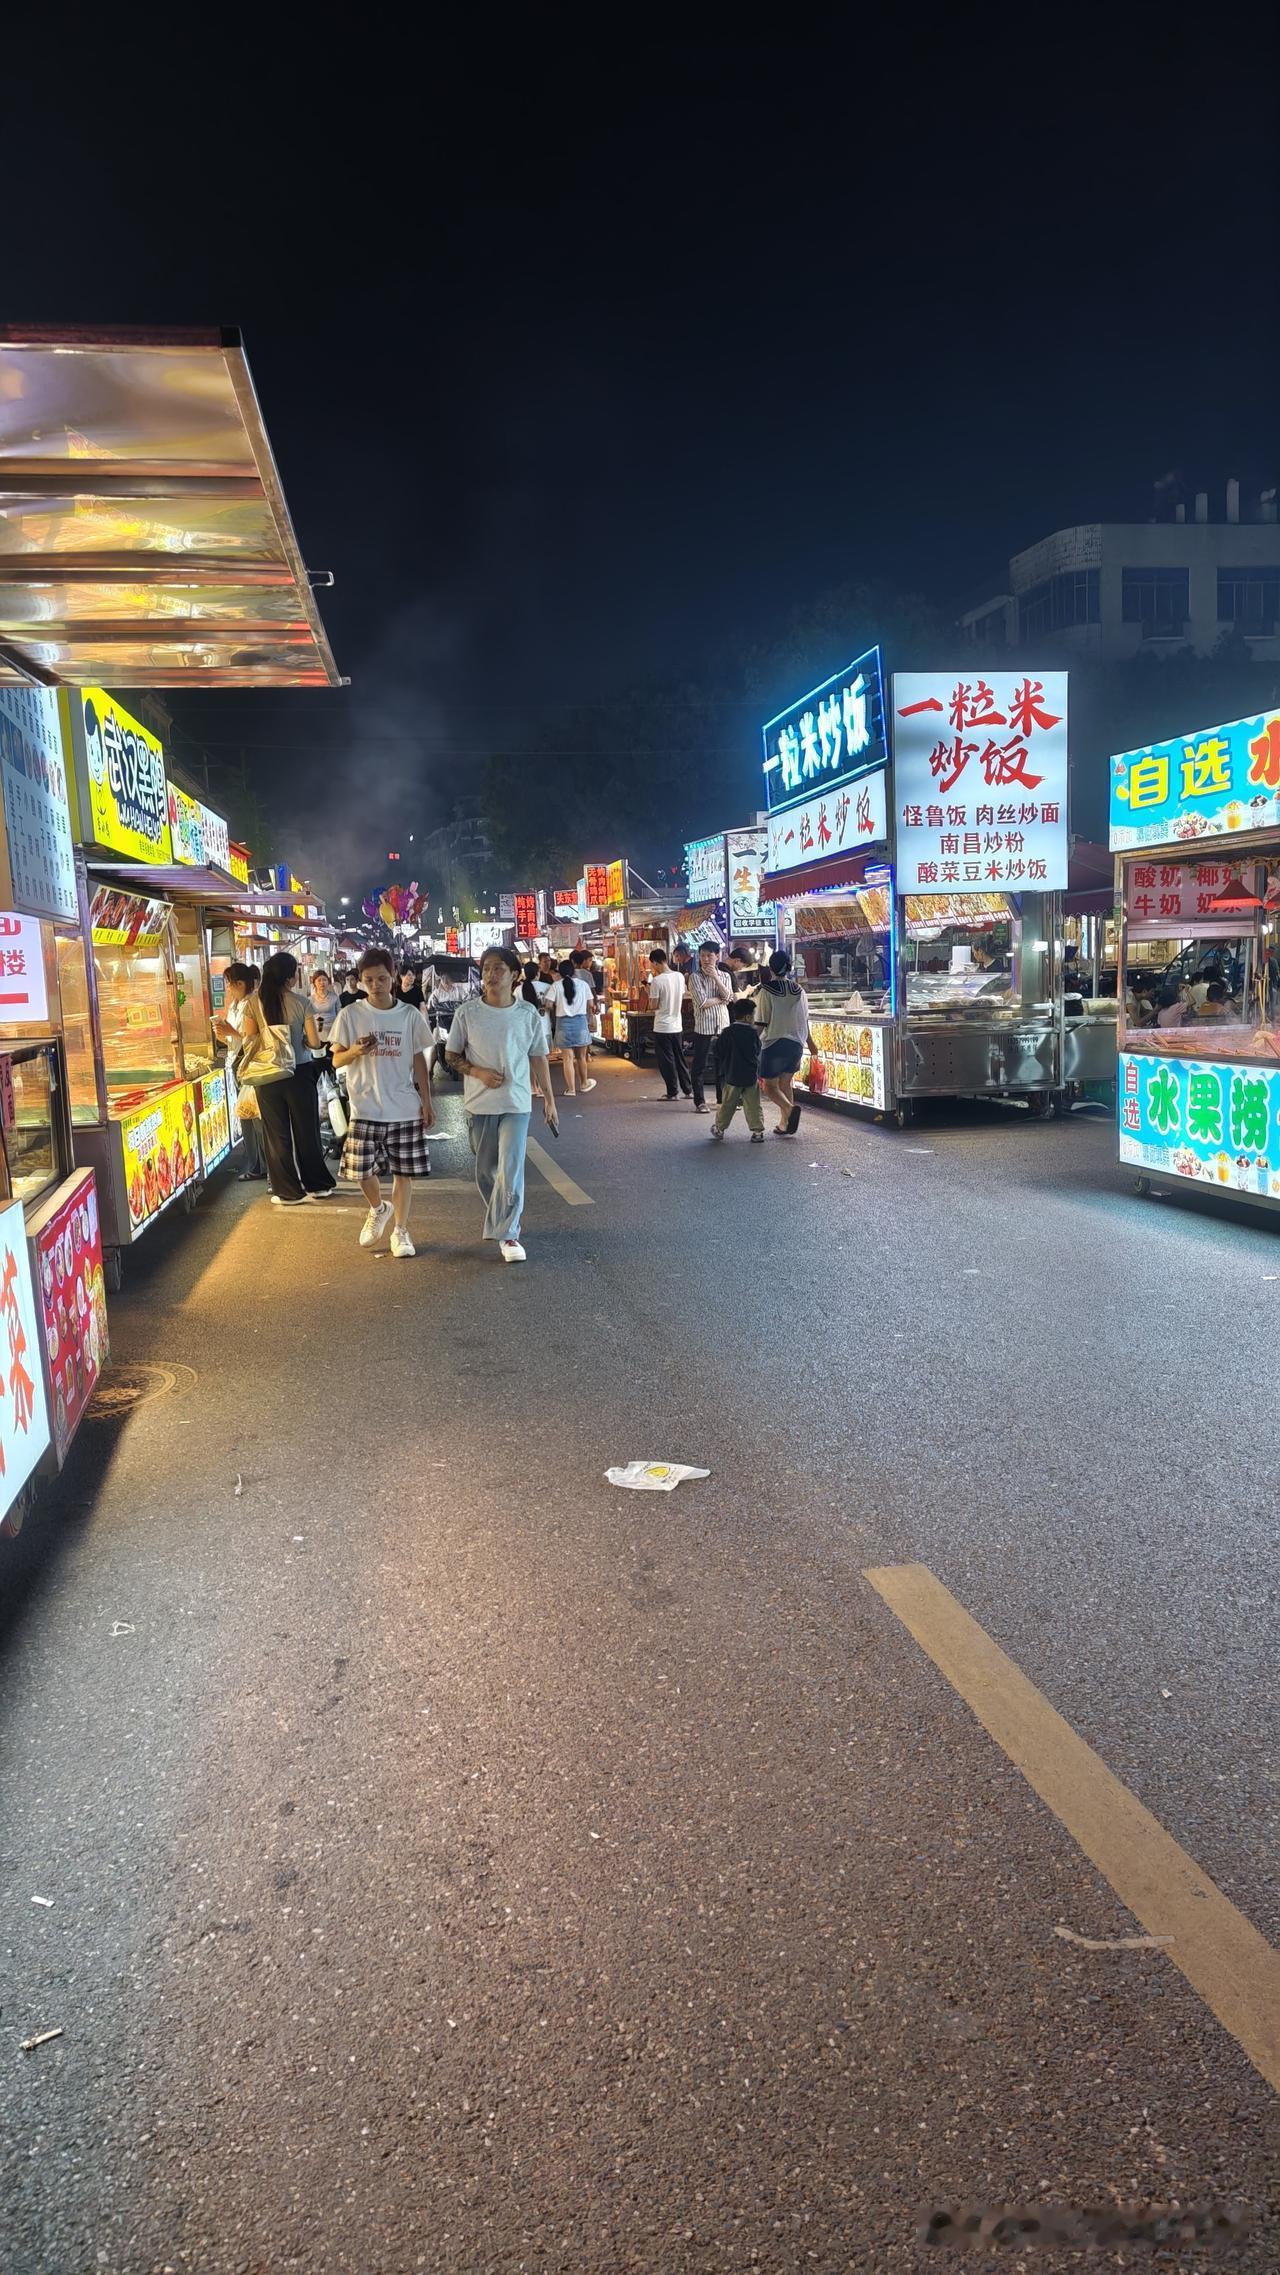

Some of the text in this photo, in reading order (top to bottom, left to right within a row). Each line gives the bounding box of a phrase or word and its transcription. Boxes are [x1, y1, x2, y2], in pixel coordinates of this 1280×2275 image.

[763, 673, 870, 791] 一粒米炒饭
[897, 678, 1063, 737] 一粒米
[929, 735, 1047, 793] 炒饭
[1129, 738, 1231, 810] 自选
[785, 786, 875, 855] 一粒米炒饭
[903, 802, 1060, 827] 怪鲁饭 肉丝炒面
[939, 831, 1025, 854] 南昌炒粉
[917, 858, 1048, 883] 酸菜豆米炒饭
[1134, 867, 1182, 889] 酸奶
[1134, 893, 1182, 916] 牛奶
[384, 1036, 402, 1047] NEW
[1124, 1062, 1141, 1130] 自选
[1148, 1066, 1270, 1150] 水果捞
